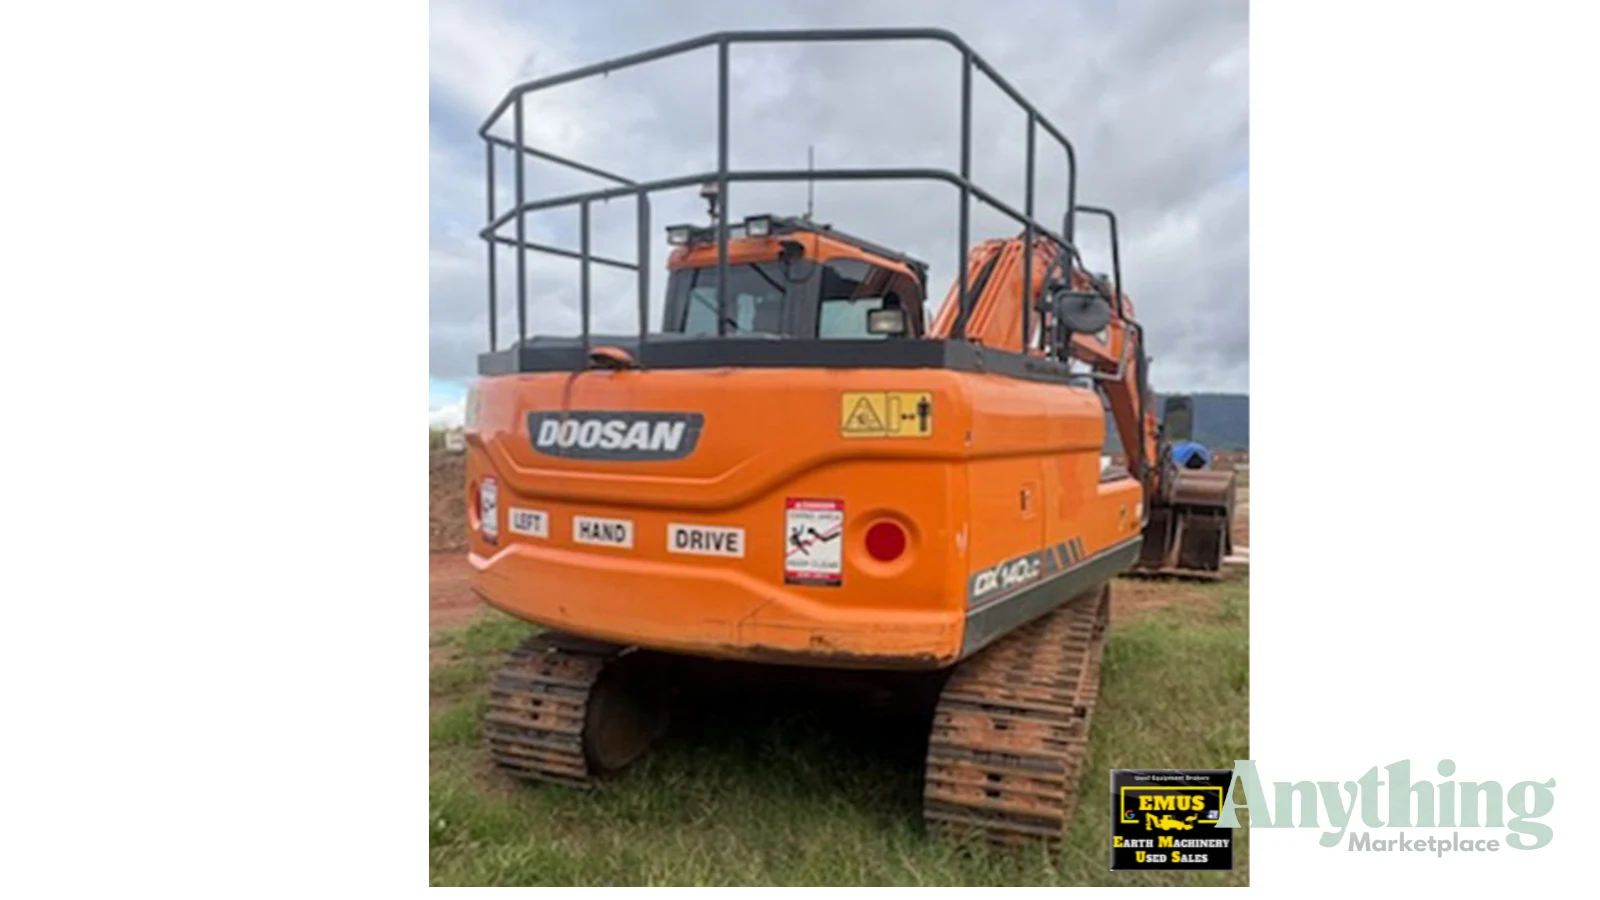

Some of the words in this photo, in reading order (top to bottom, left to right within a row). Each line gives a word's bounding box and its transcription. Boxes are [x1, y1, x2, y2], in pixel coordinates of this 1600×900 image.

[536, 419, 685, 450] DOOSAN
[513, 513, 541, 532] LEFT
[579, 520, 626, 543] HAND
[675, 529, 739, 553] DRIVE
